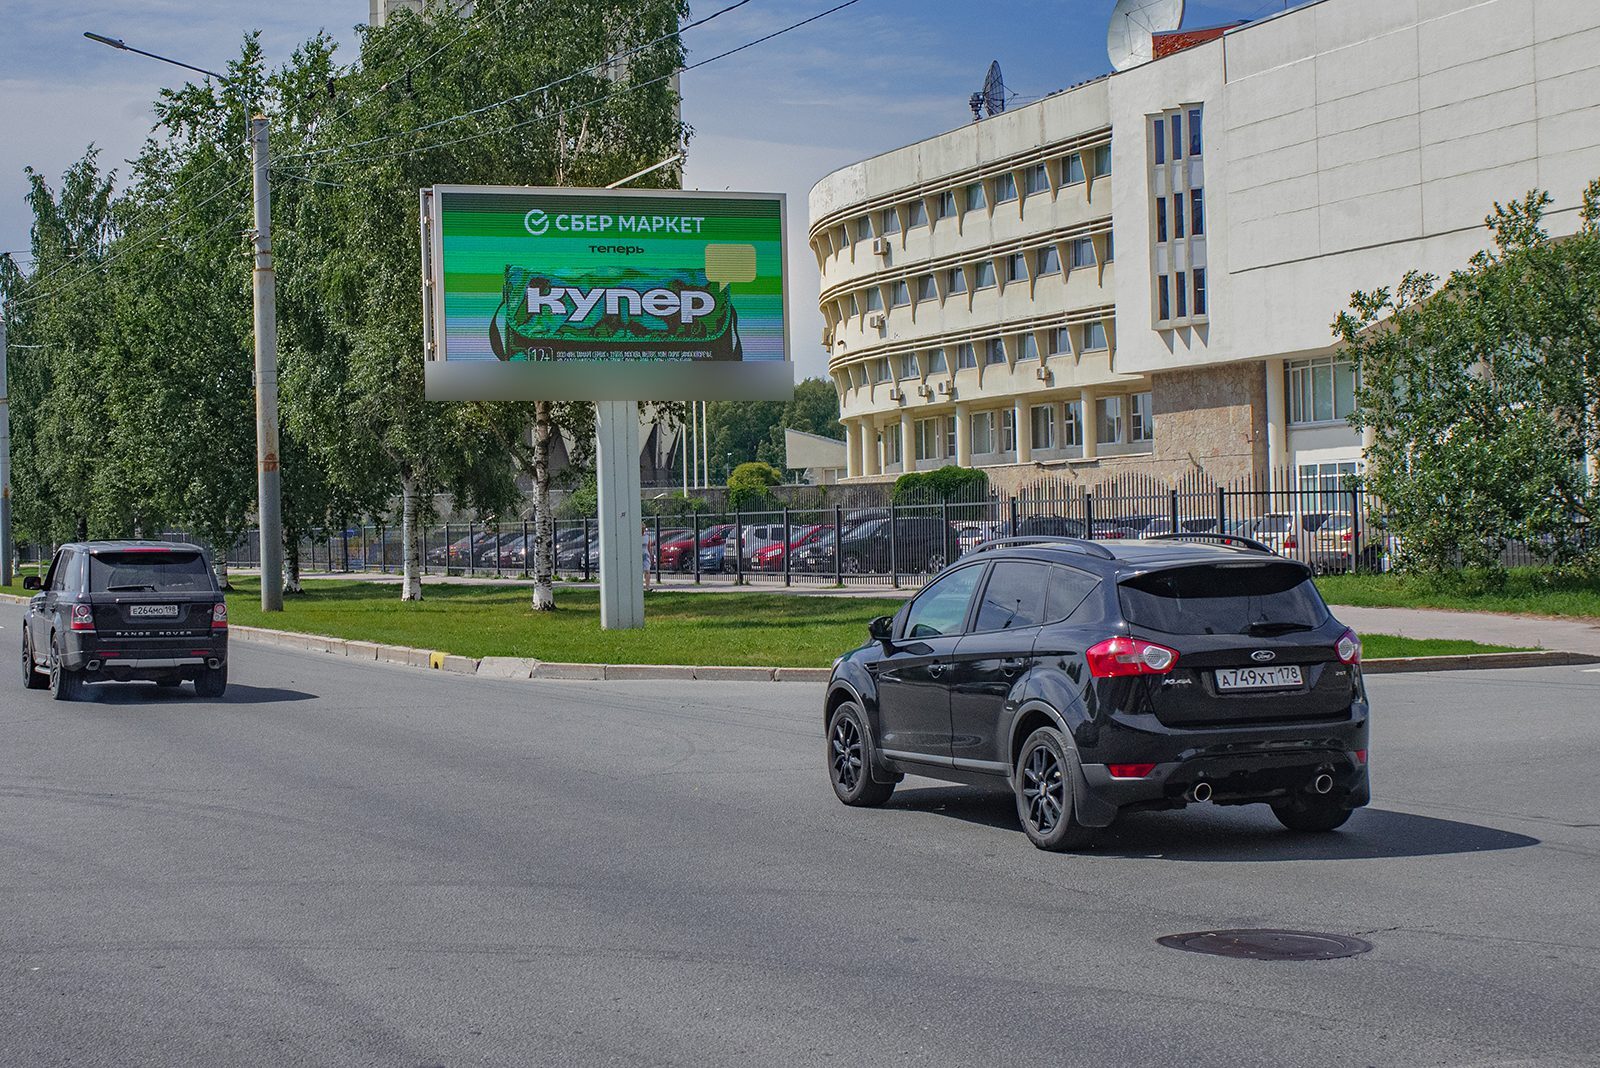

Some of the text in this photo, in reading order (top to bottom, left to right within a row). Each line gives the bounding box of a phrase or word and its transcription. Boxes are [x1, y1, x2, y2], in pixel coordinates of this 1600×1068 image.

[555, 214, 705, 234] СБЕР МАРКЕТ
[588, 244, 645, 255] теперь
[526, 286, 716, 324] купер
[1222, 667, 1299, 687] А749ХТ 178
